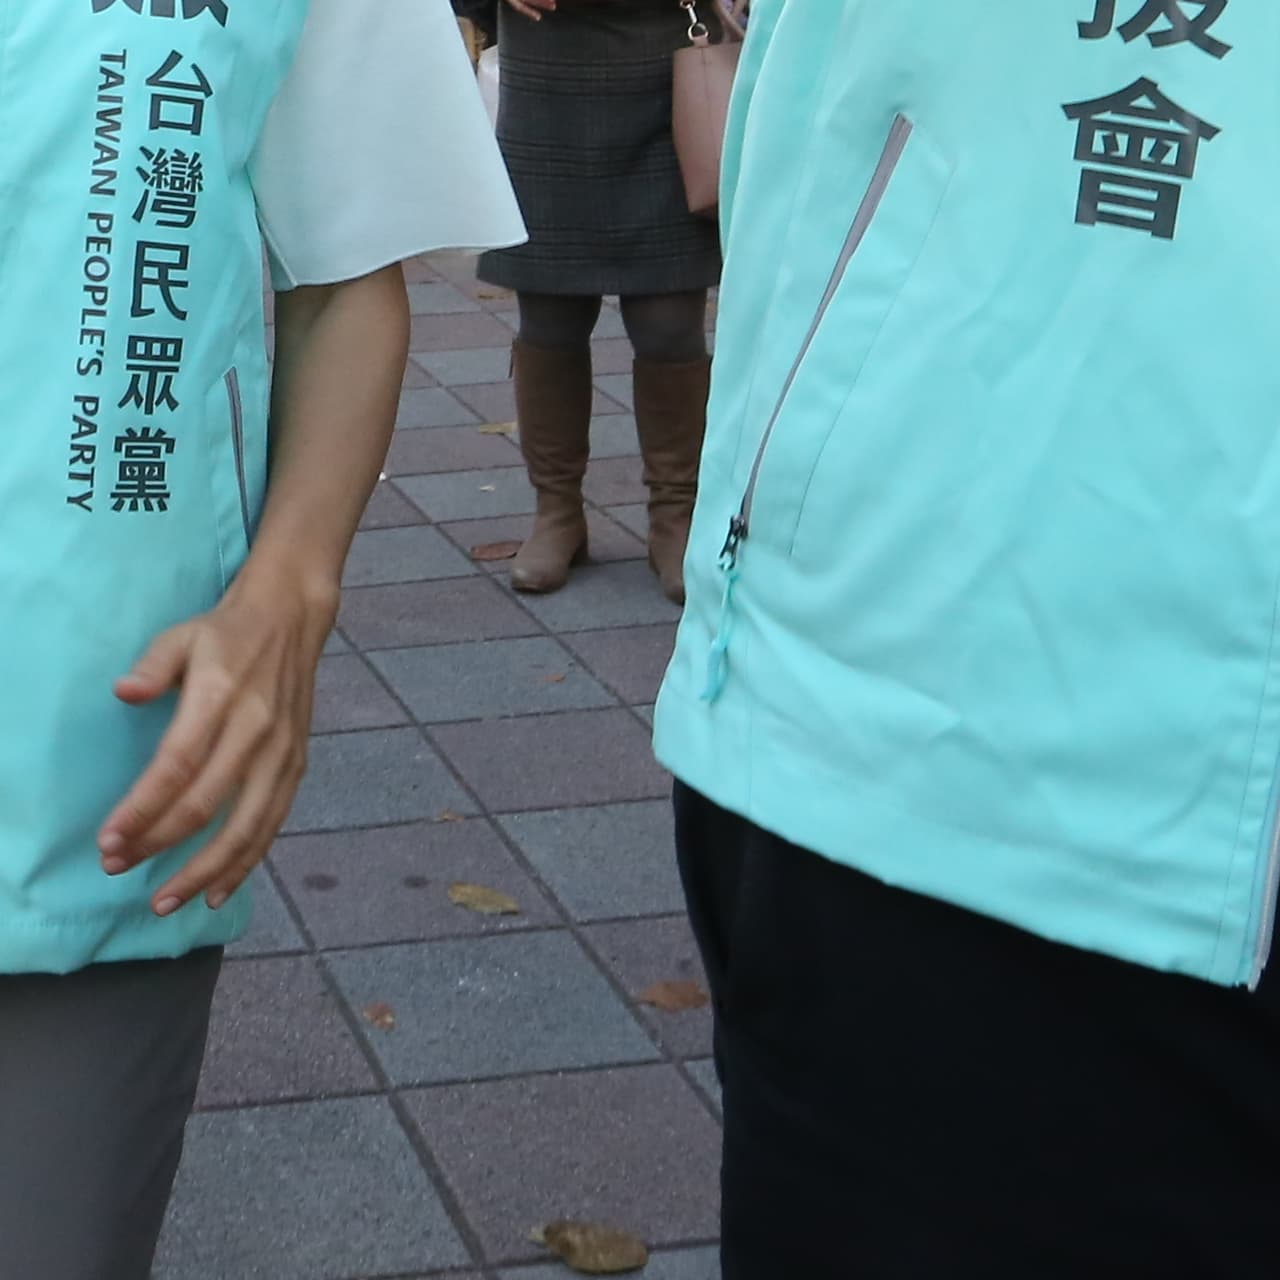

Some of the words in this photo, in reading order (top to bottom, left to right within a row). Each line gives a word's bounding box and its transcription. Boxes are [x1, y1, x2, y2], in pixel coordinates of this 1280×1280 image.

[88, 48, 128, 198] TAIWAN
[75, 211, 114, 378] PEOPLE'S
[110, 49, 214, 514] 台灣民眾黨
[66, 394, 102, 513] PARTY
